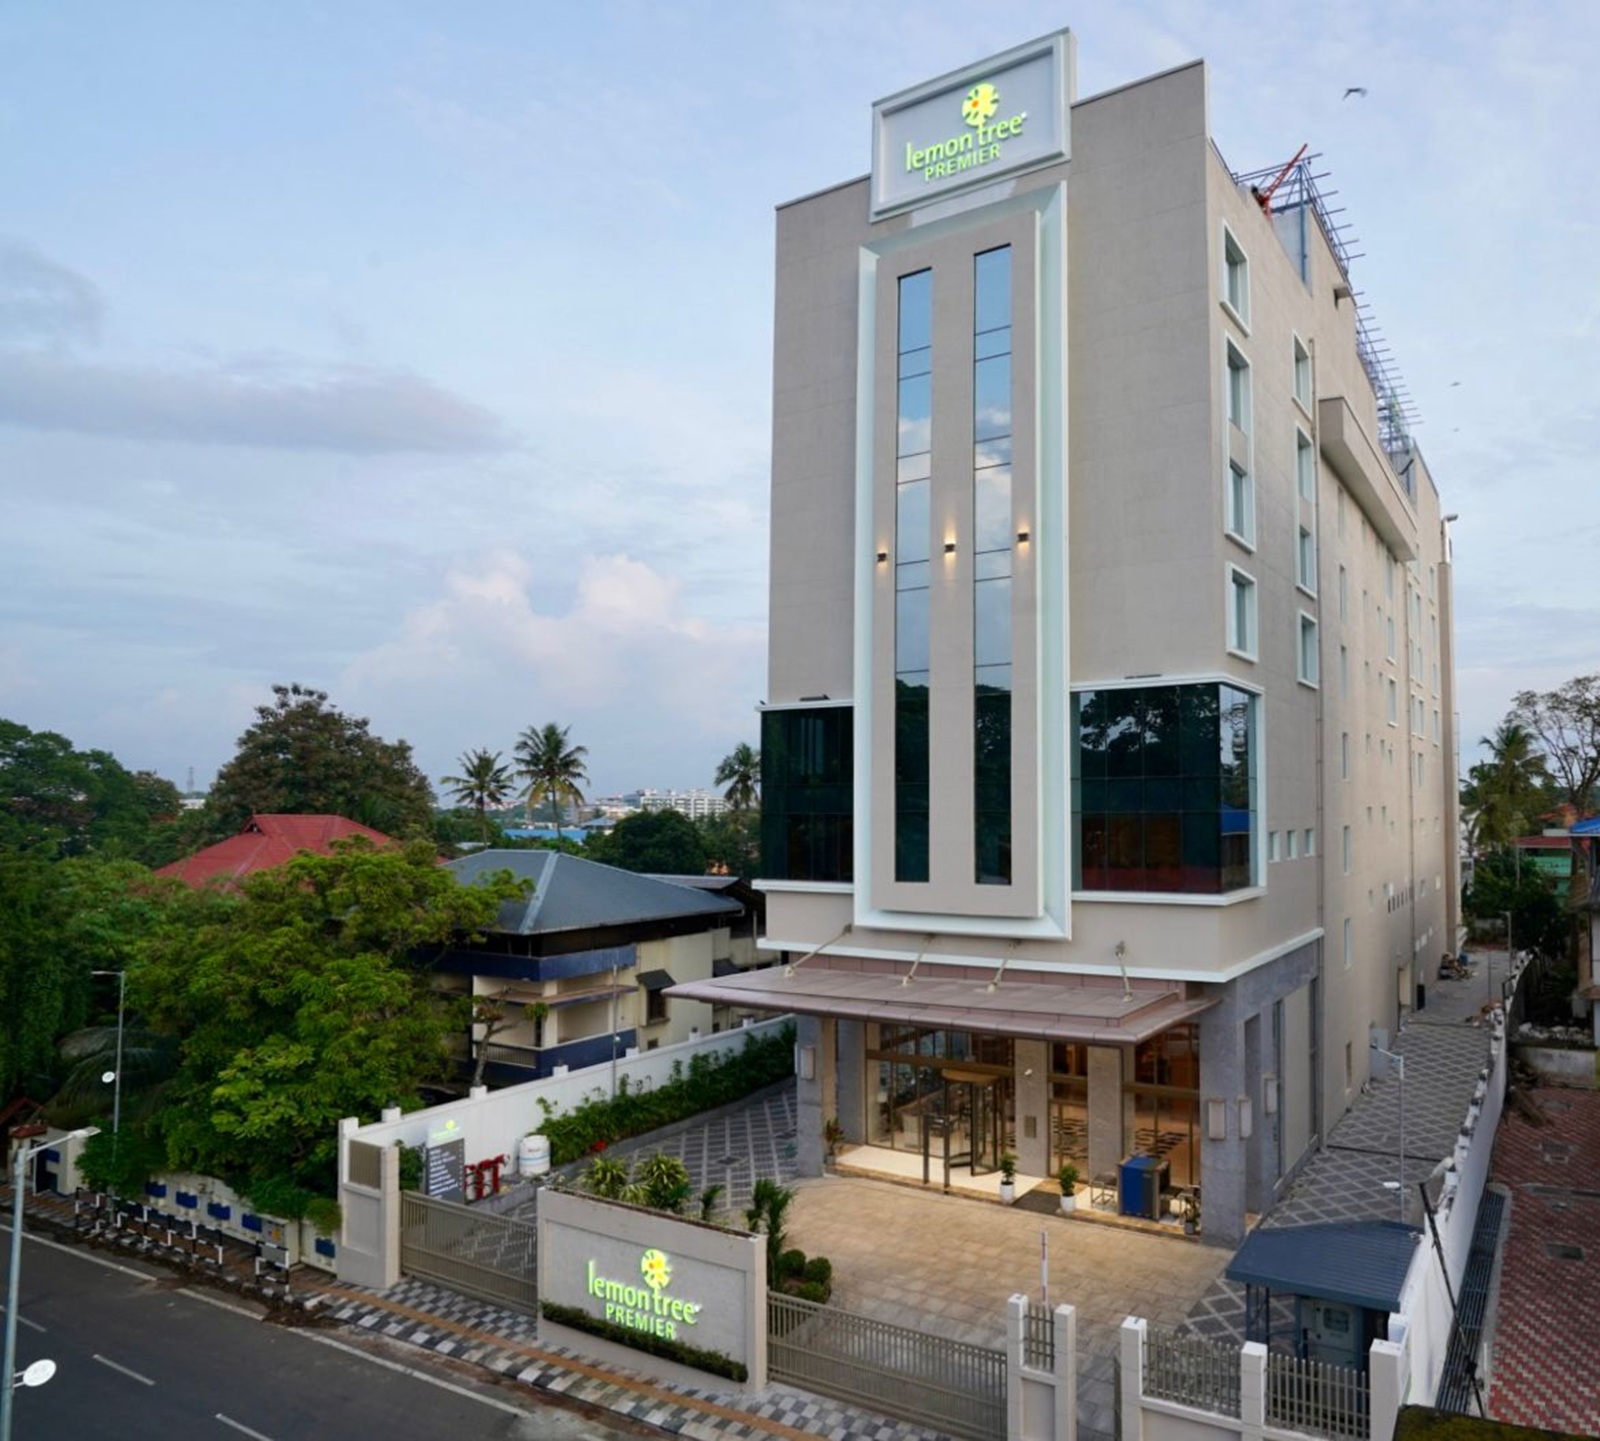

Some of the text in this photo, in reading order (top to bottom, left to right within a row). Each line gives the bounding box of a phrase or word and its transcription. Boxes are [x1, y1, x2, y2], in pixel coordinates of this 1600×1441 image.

[905, 115, 1022, 171] lemon tree
[924, 144, 1000, 182] PREMIER
[588, 1260, 699, 1325] lemon tree
[606, 1303, 676, 1341] PREMIER
